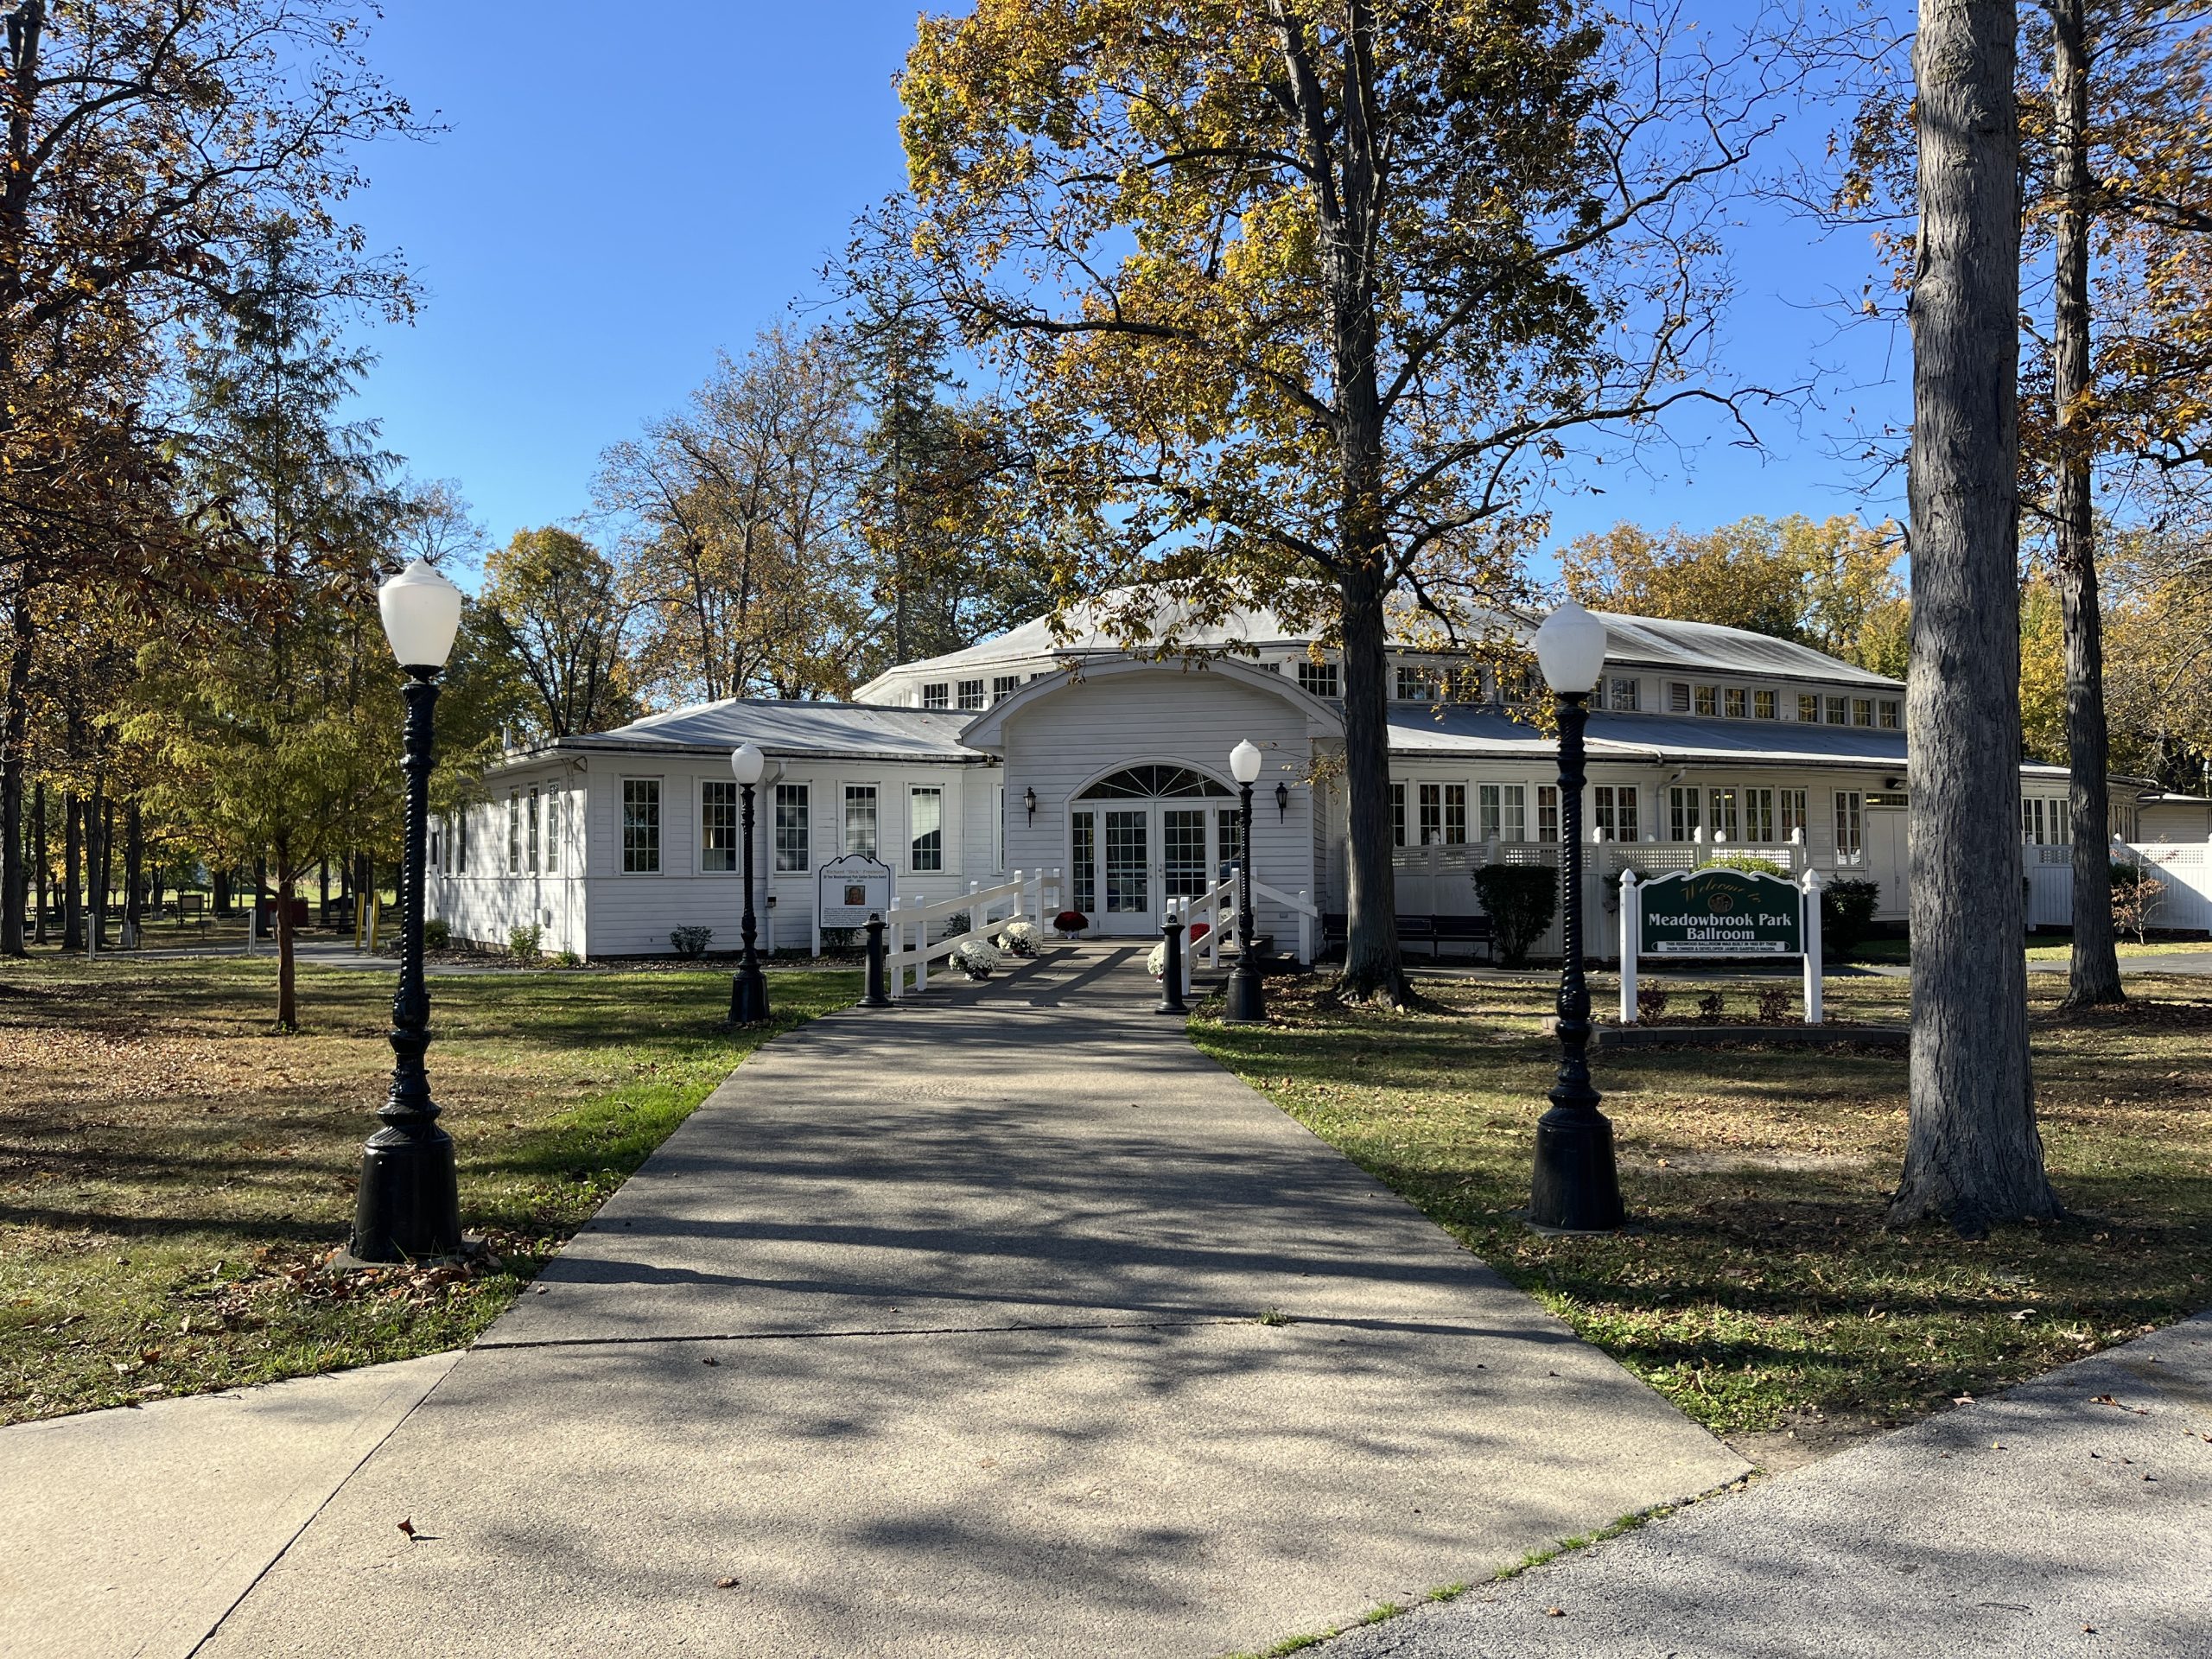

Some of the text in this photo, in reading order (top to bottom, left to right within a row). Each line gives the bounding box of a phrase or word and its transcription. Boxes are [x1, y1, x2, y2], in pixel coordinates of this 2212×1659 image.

[1680, 876, 1745, 903] Welcome
[1649, 912, 1792, 926] Meadowbrook Park
[1687, 927, 1755, 940] Ballroom
